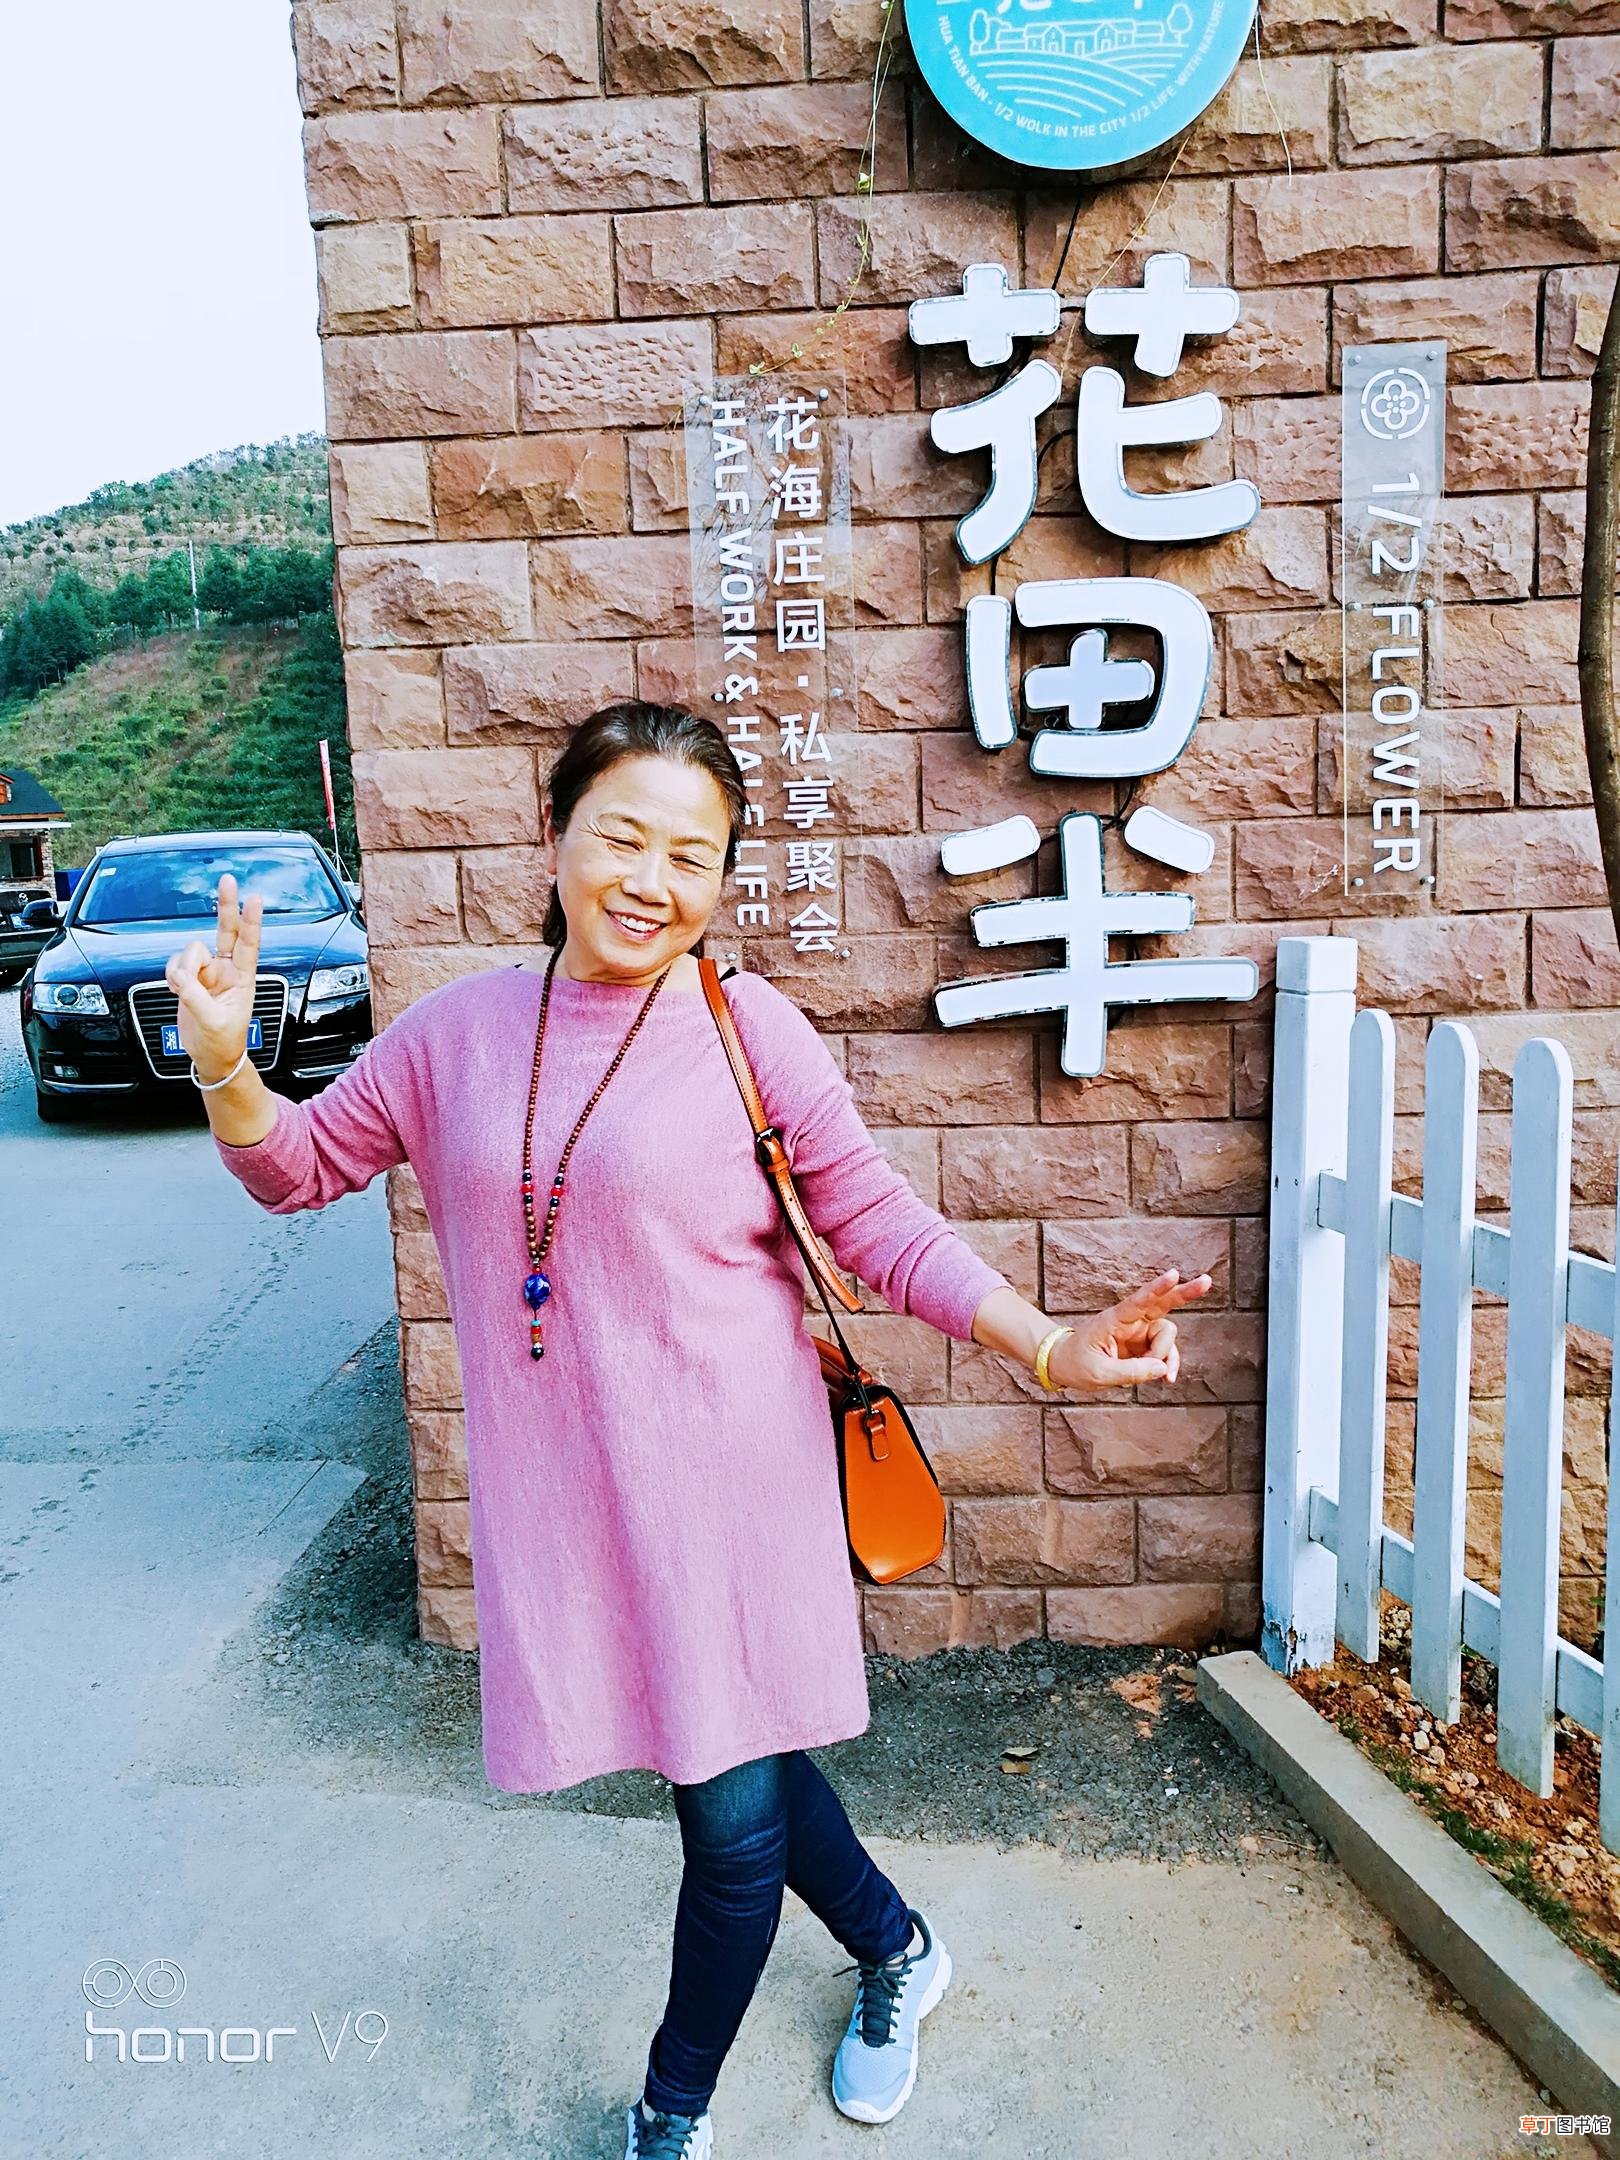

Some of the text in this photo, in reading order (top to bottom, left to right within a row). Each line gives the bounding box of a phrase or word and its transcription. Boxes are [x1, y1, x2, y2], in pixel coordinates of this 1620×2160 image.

[938, 15, 954, 46] HUA
[948, 45, 970, 78] TIAN
[965, 74, 989, 102] BAN
[994, 102, 1014, 121] 1/2
[1054, 125, 1069, 138] IN
[1072, 124, 1097, 138] THE
[1099, 116, 1127, 136] CITY
[1130, 105, 1151, 124] 1/2
[1151, 84, 1178, 111] LIFE
[1174, 54, 1202, 87] WITH
[1198, 0, 1225, 55] NATURE
[711, 399, 750, 516] HALF
[718, 526, 759, 663] WORK
[724, 673, 759, 705] &
[908, 251, 1260, 1078] 花田半
[1366, 471, 1423, 875] 1/2 FLOWER
[734, 839, 770, 927] LIFE
